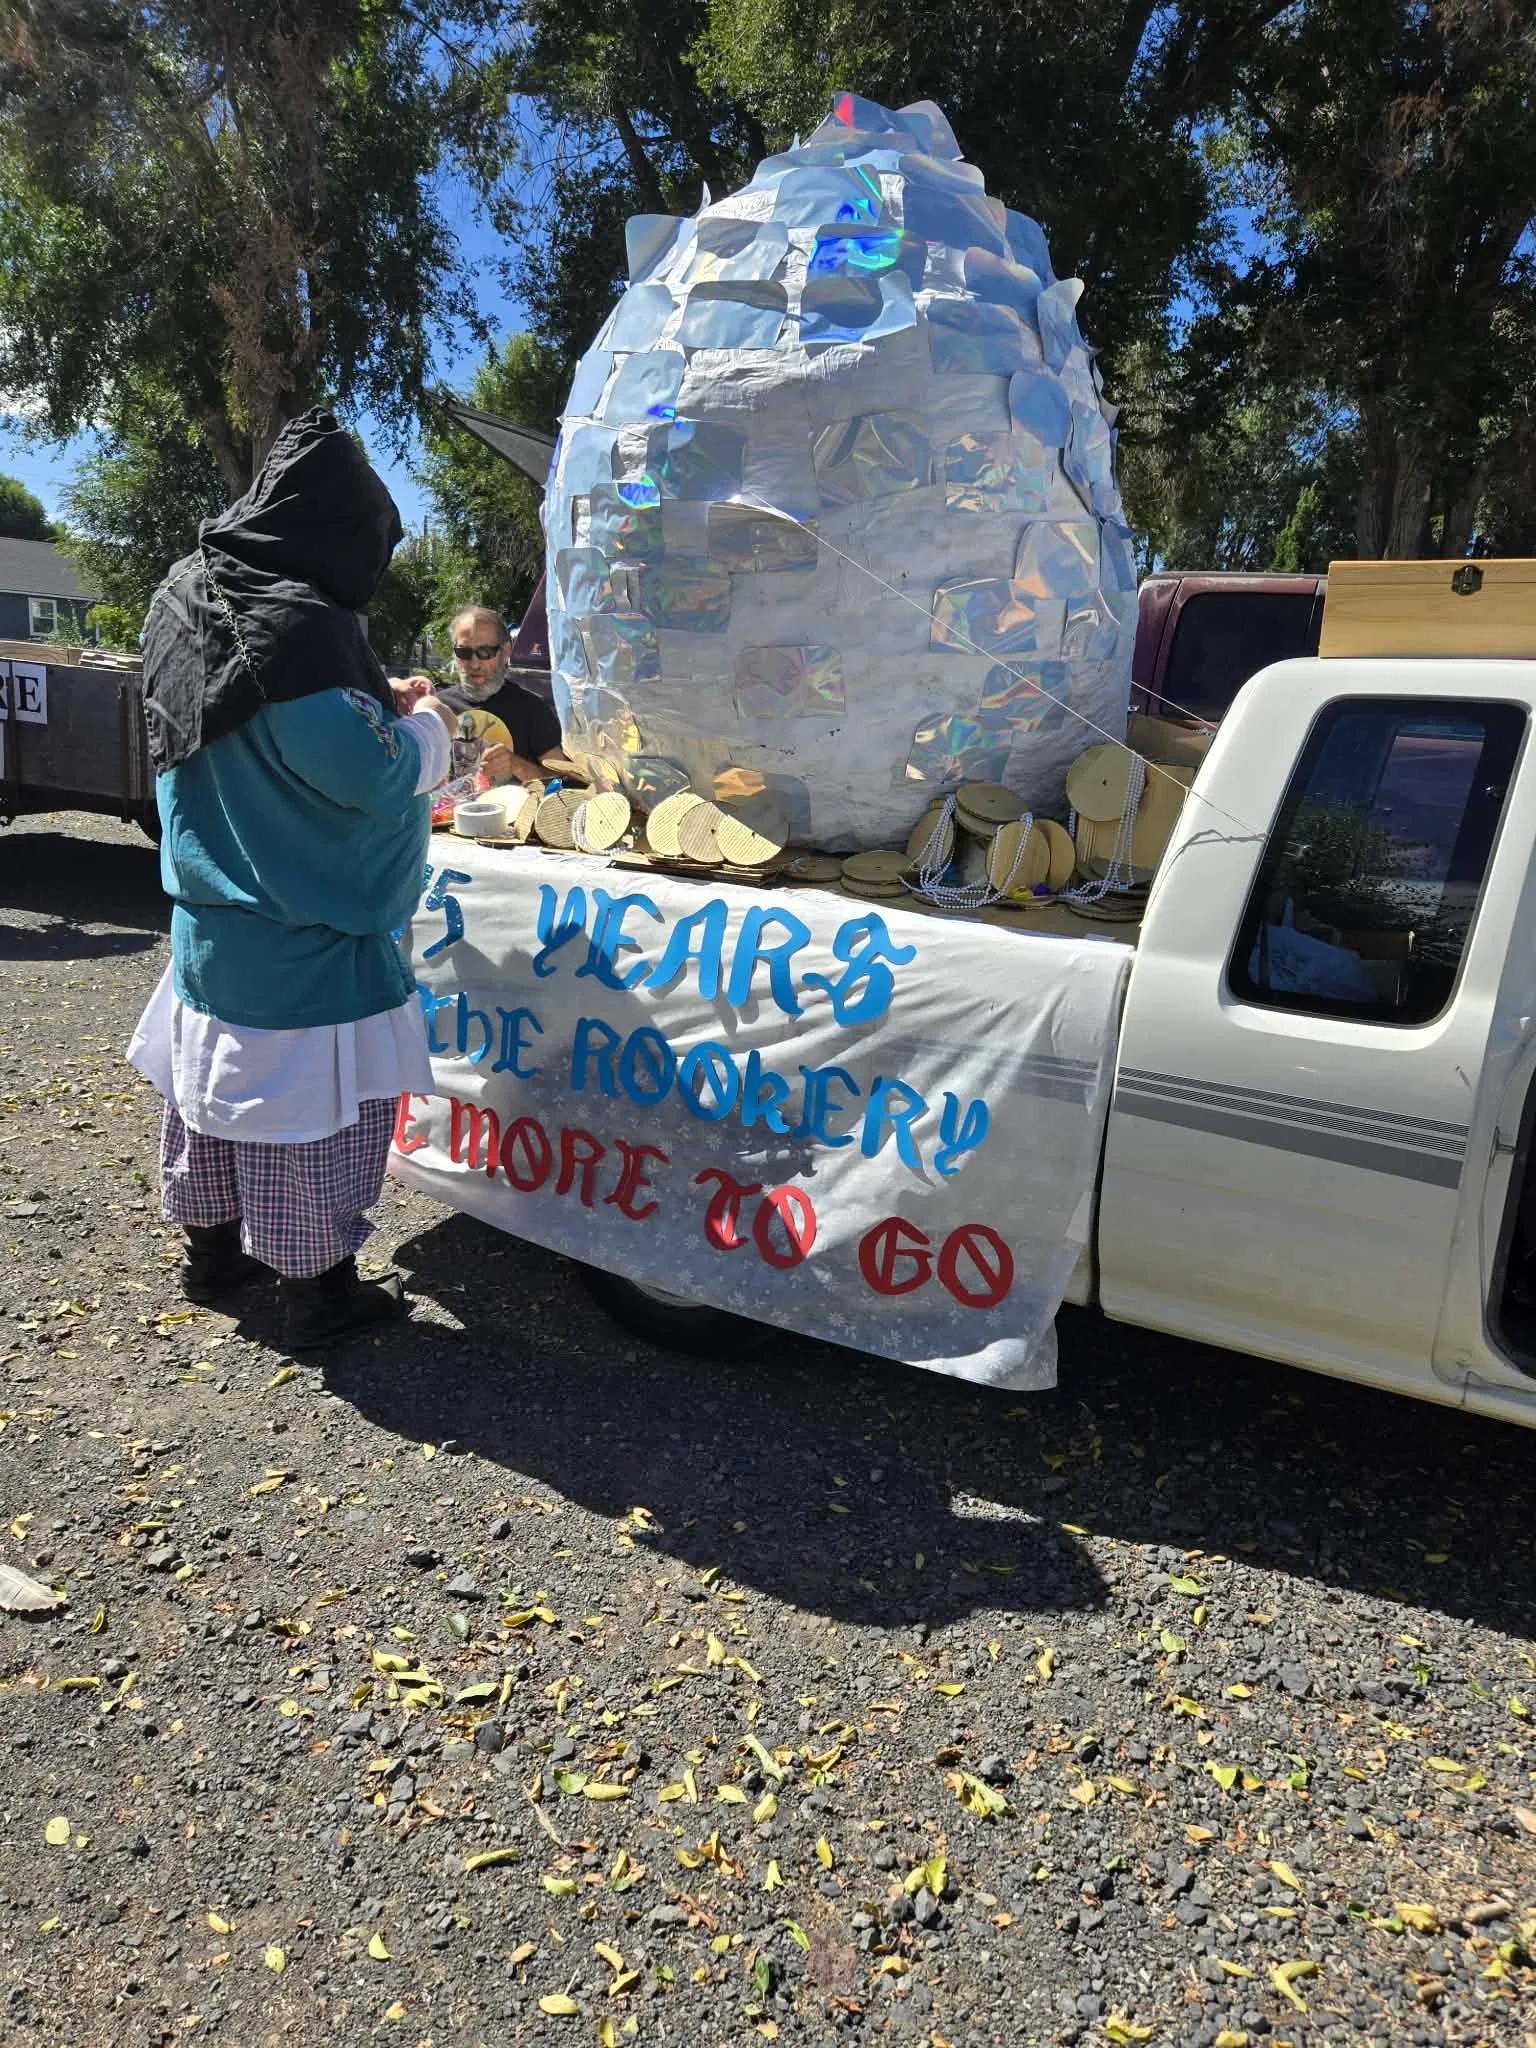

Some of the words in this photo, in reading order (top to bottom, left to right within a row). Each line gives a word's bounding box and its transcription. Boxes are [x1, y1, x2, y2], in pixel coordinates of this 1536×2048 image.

[532, 884, 918, 1028] YEARS
[695, 1167, 817, 1270] TO
[858, 1216, 1015, 1309] GO
